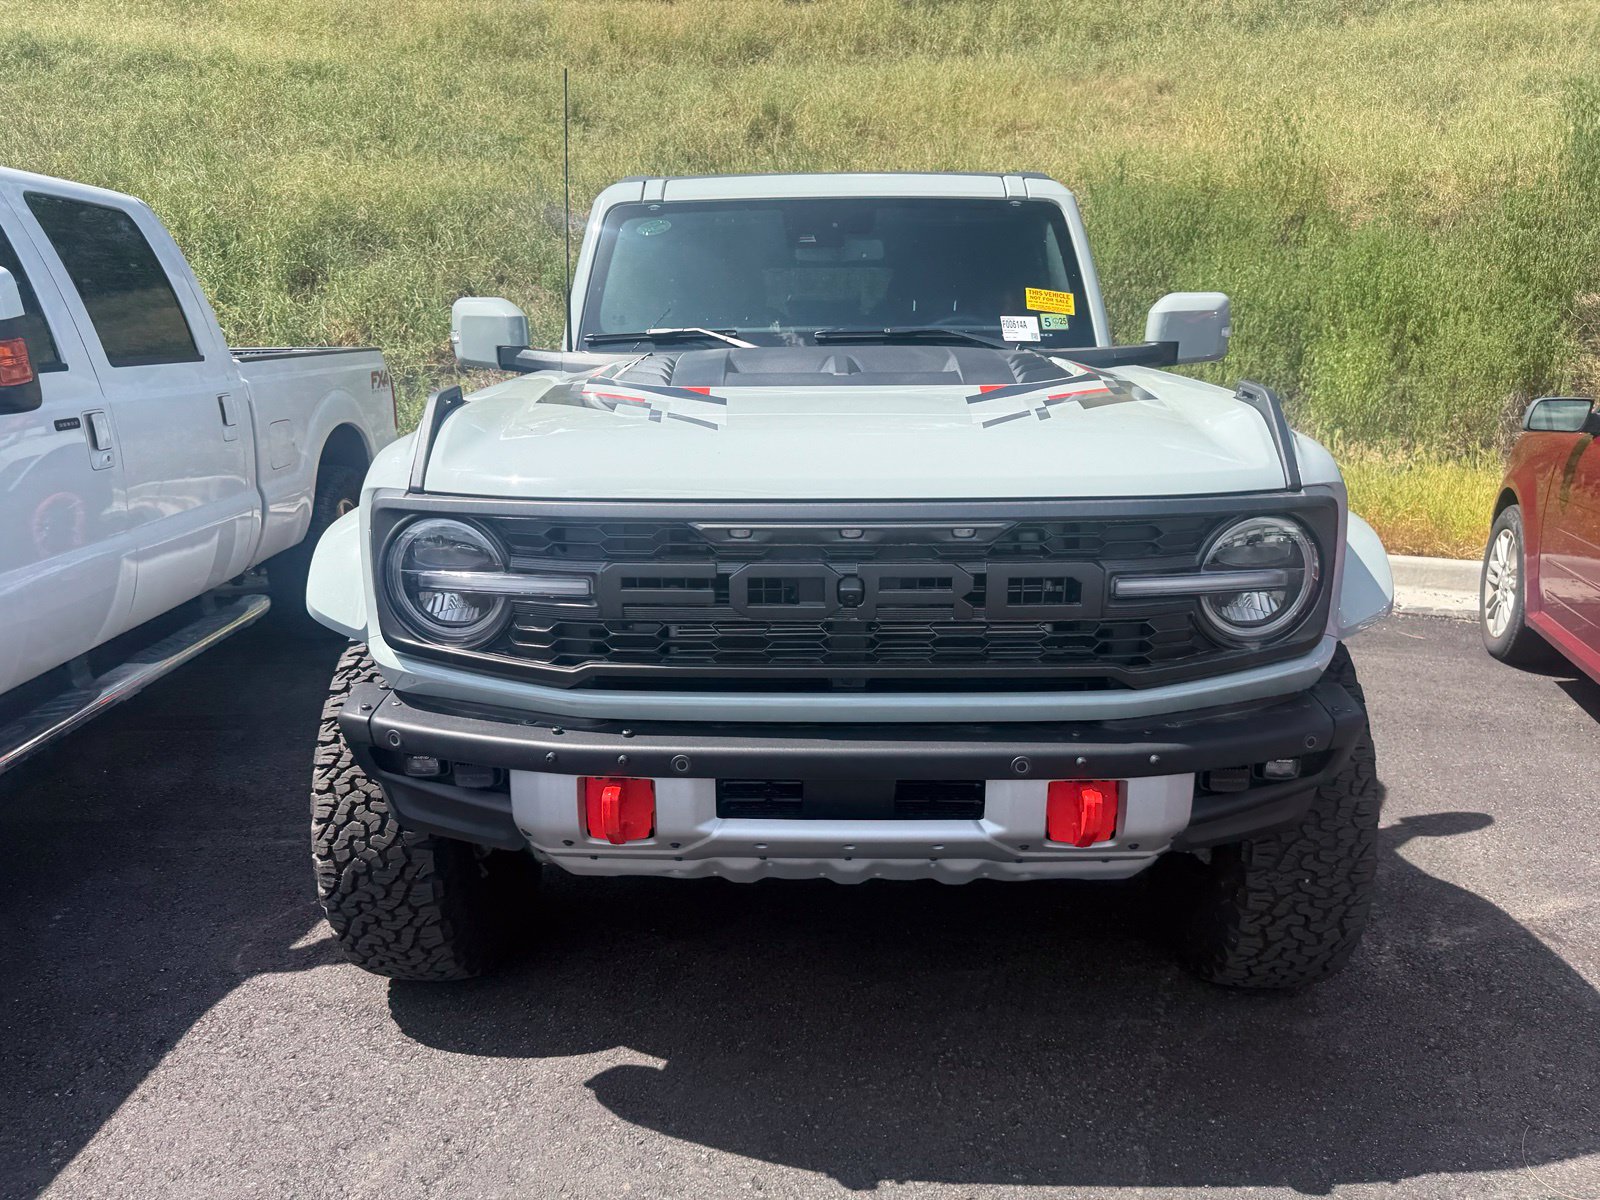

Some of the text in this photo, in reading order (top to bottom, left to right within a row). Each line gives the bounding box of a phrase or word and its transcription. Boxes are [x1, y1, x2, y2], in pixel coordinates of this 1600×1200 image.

[1044, 291, 1071, 300] VEHICLE
[1044, 317, 1067, 327] 5 25
[371, 370, 389, 389] FX4
[600, 562, 1102, 620] FORD
